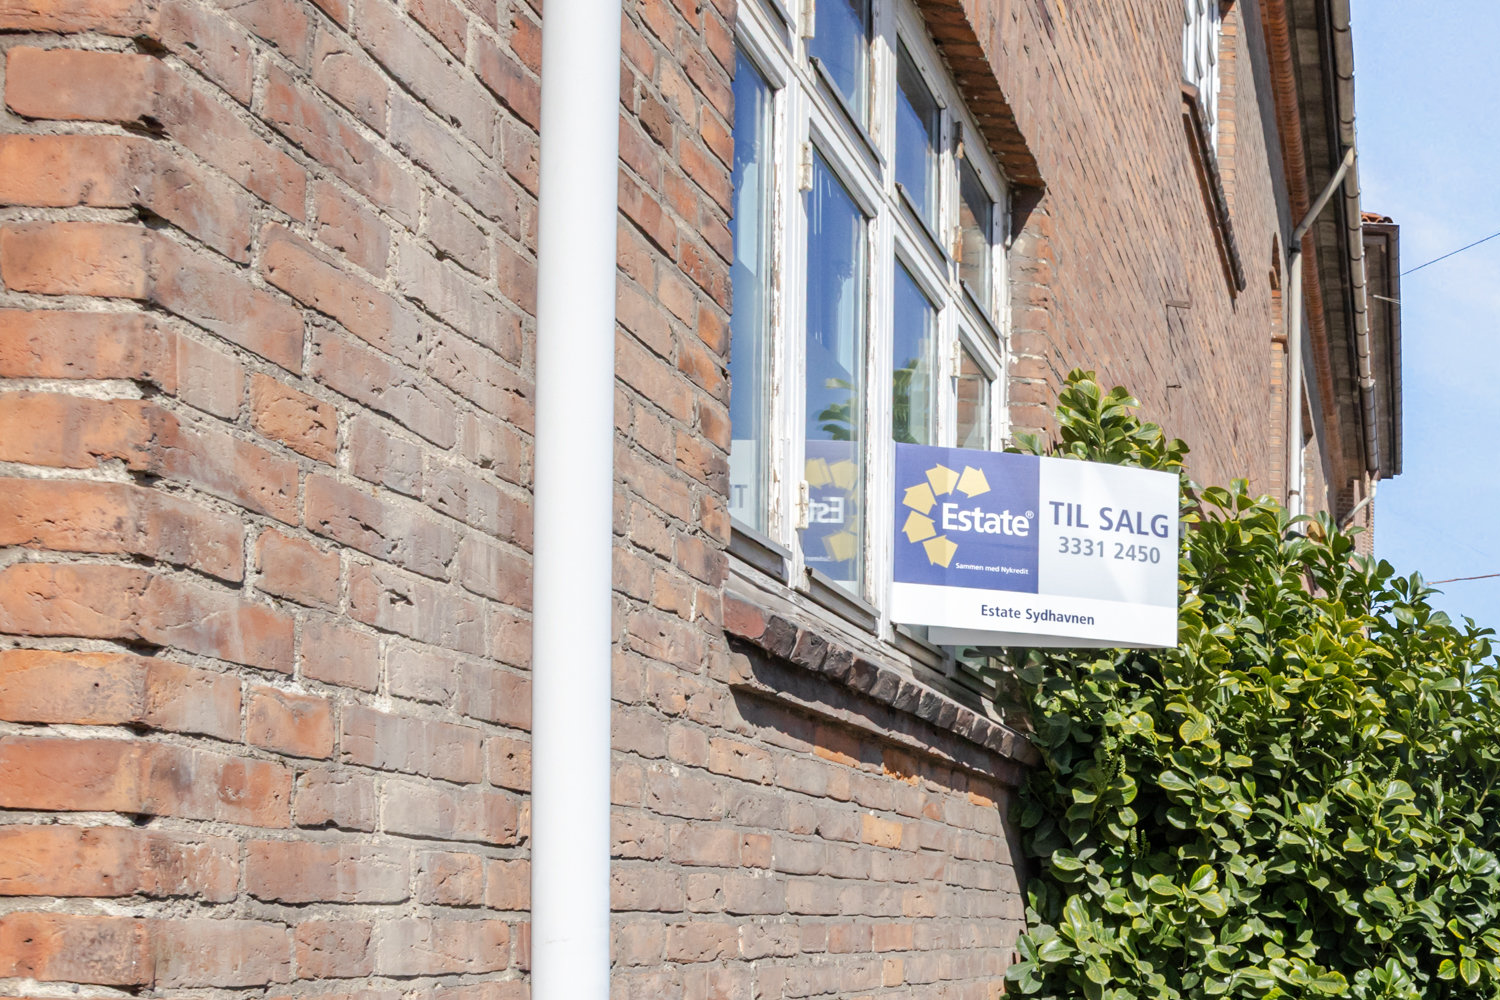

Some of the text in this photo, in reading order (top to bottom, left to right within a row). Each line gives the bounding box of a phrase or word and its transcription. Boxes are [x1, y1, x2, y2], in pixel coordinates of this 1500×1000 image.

[1049, 501, 1169, 538] TIL SALG
[1058, 536, 1161, 564] 3331 2450
[955, 562, 1029, 576] Sammen med Nykredit
[981, 604, 1095, 626] Estate Sydhavnen
